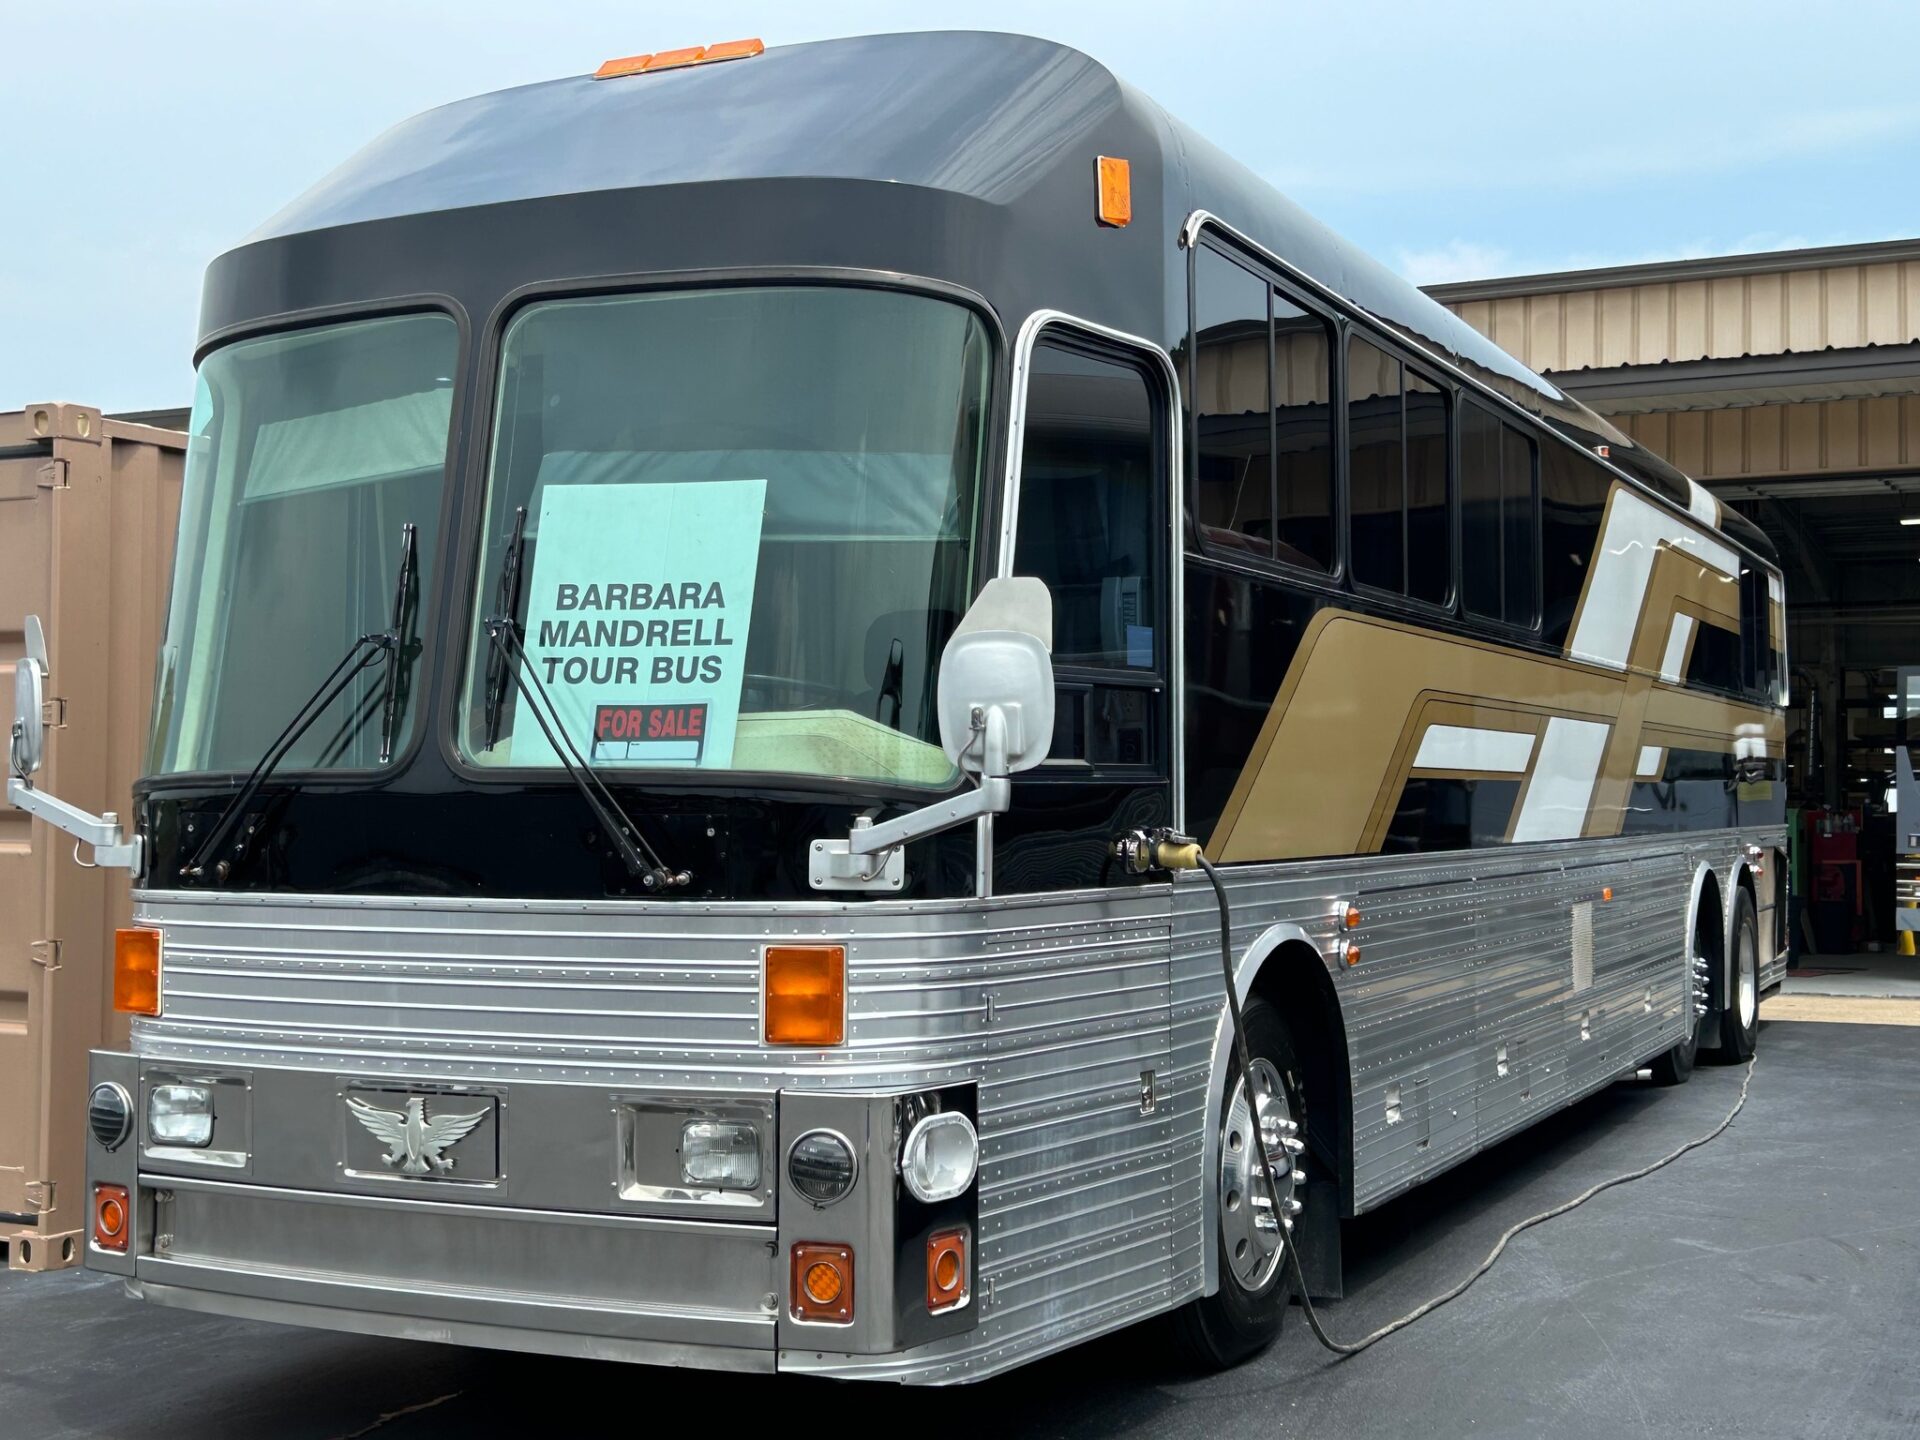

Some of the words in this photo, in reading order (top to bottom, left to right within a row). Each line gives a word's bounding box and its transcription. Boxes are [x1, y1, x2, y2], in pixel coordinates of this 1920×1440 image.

[556, 581, 726, 611] BARBARA
[538, 618, 734, 648] MANDRELL
[541, 655, 640, 685] TOUR
[650, 654, 723, 684] BUS
[597, 708, 643, 738] FOR
[647, 707, 704, 738] SALE
